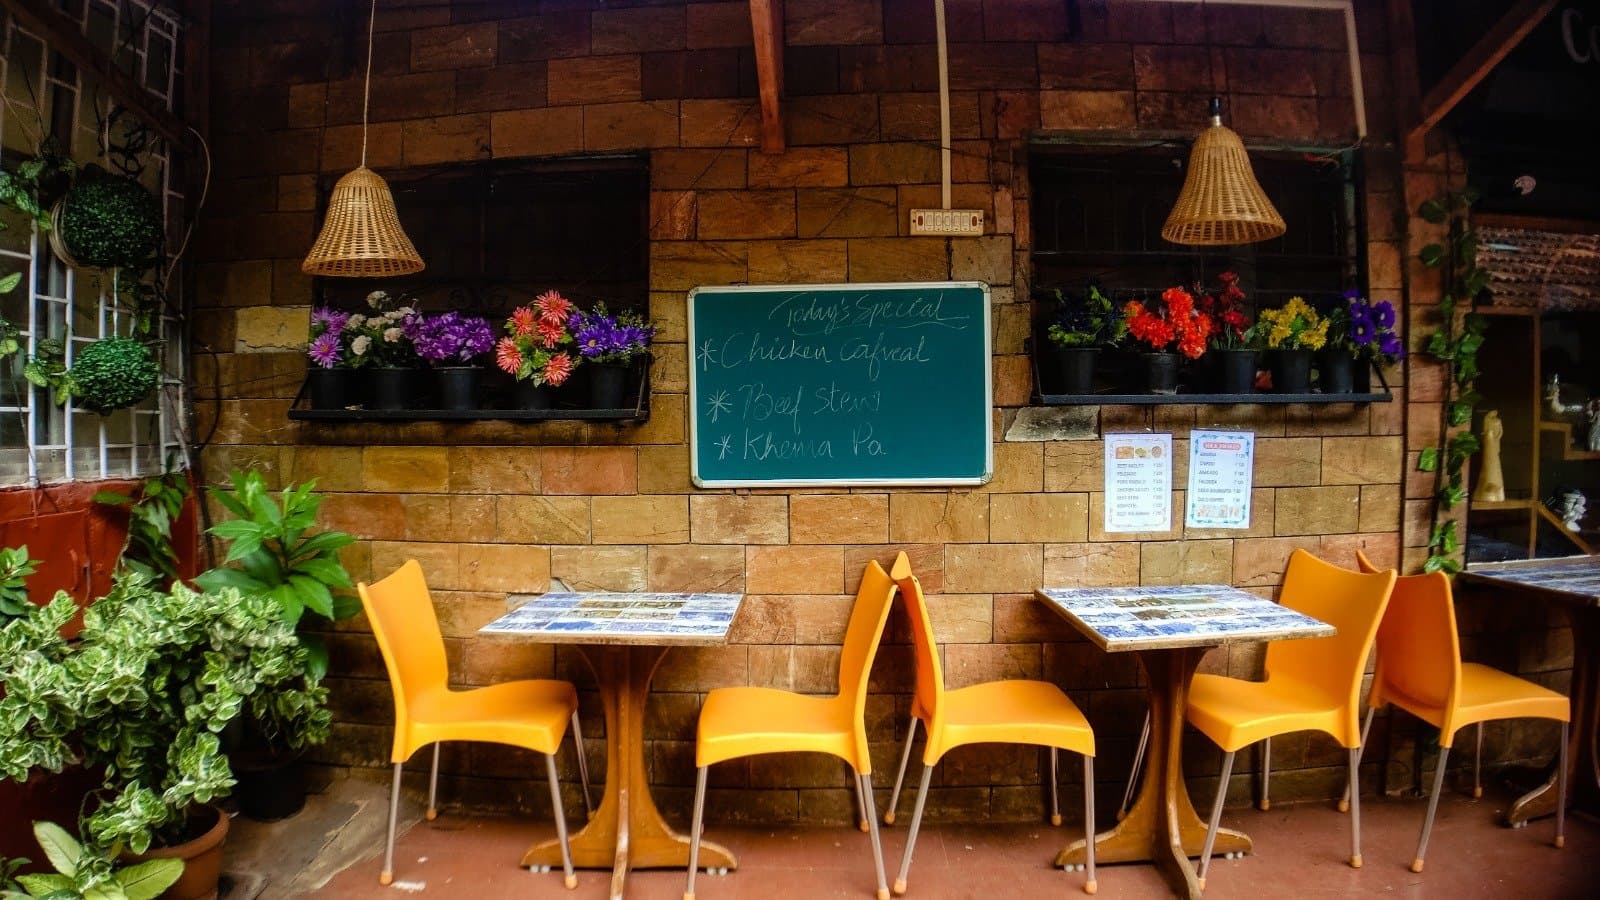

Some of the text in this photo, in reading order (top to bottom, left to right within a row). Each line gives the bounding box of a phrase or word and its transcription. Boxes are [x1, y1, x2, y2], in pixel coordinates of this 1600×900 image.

[769, 292, 966, 335] Today's Special
[720, 332, 832, 368] Chicken
[738, 383, 803, 436] Beef
